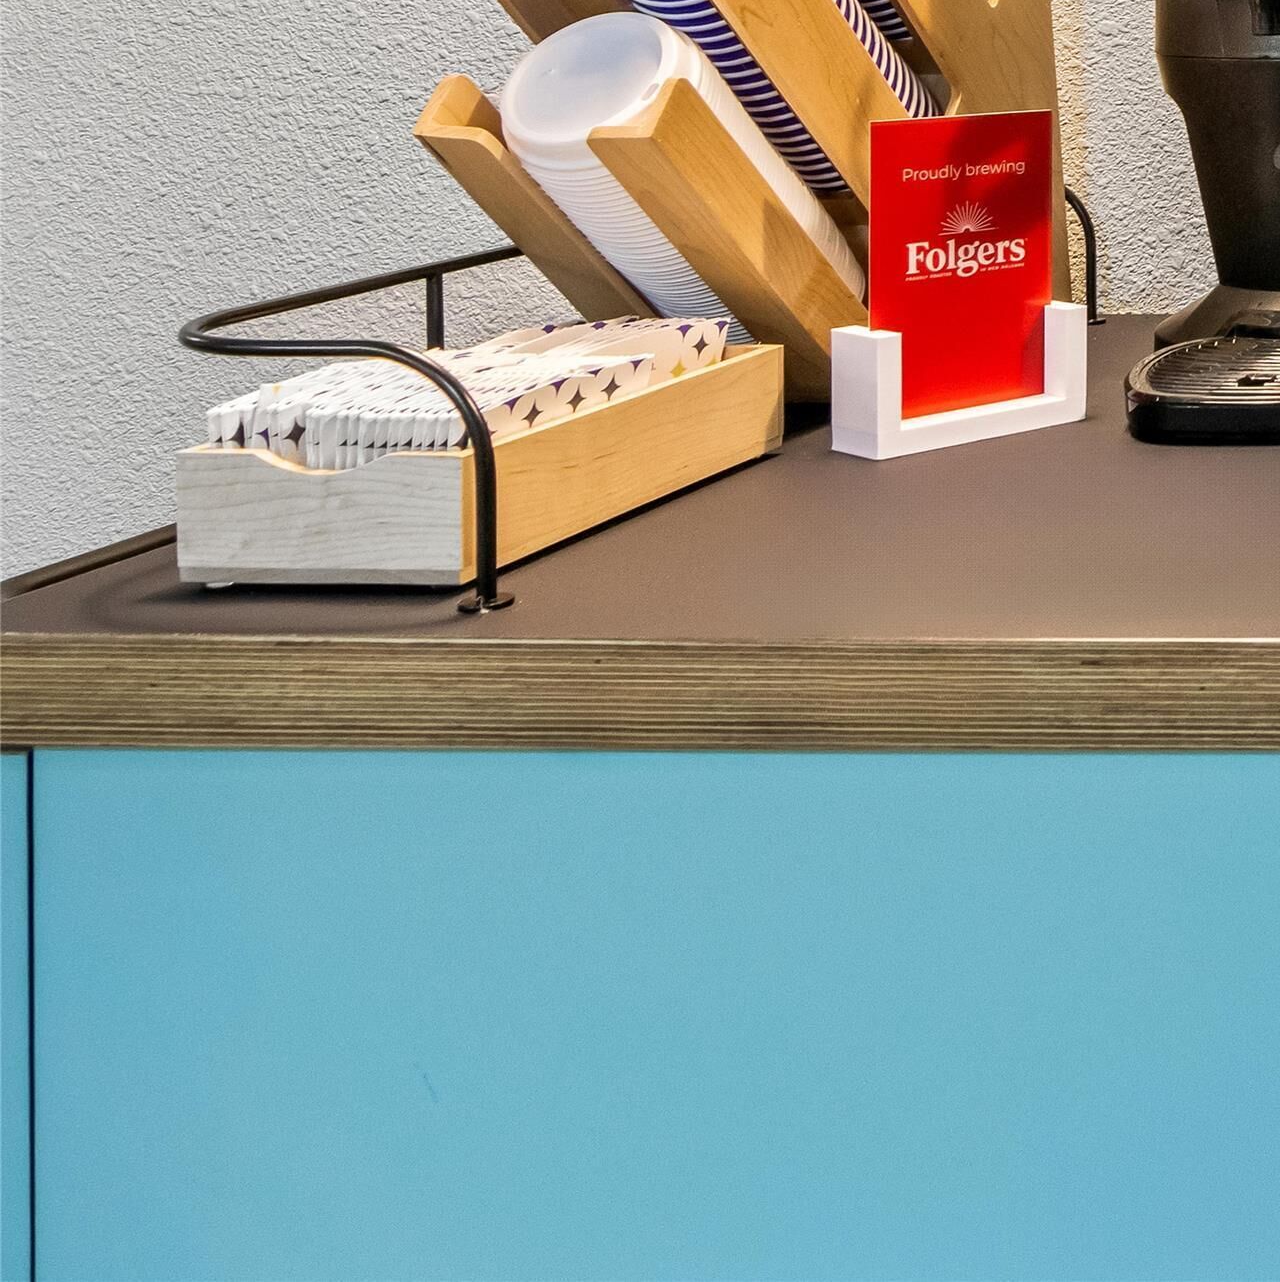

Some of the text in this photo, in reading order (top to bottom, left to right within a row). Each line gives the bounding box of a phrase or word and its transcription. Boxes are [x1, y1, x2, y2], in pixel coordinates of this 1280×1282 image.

[903, 160, 1025, 182] Proudly brewing
[905, 238, 1026, 277] Folgers
